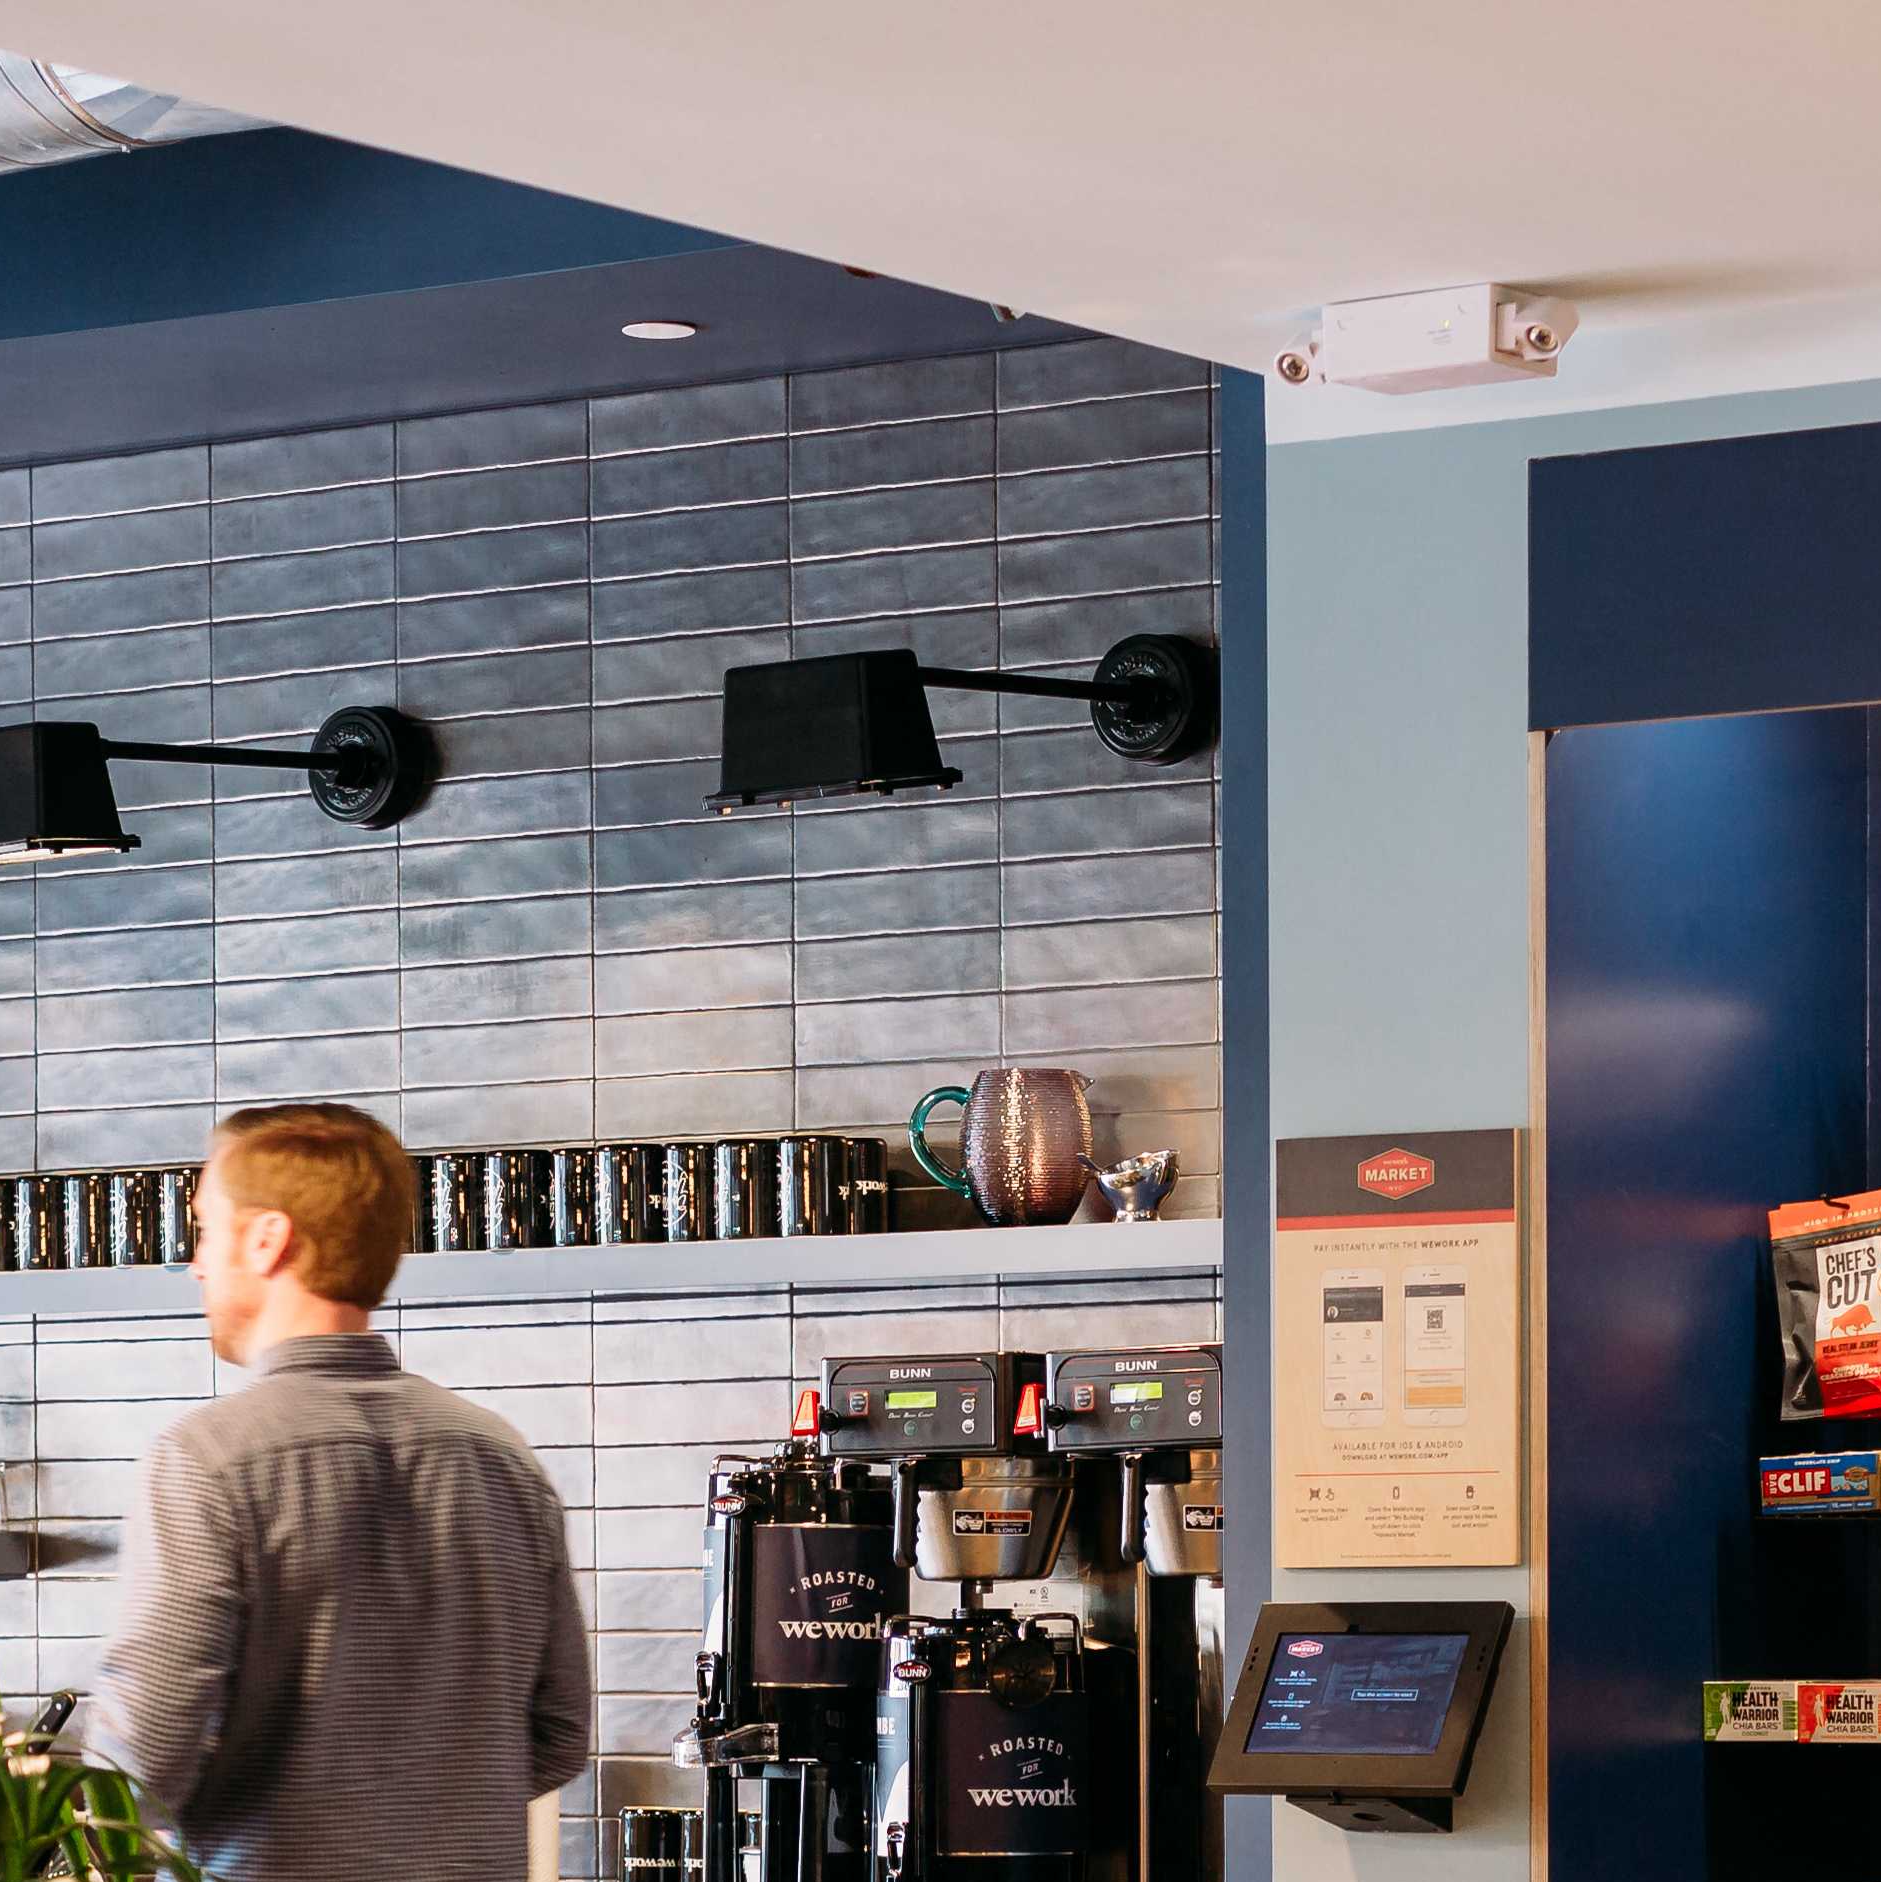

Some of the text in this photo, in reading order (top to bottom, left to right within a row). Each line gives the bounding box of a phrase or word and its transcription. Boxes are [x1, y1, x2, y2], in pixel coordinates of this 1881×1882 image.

[1365, 1167, 1428, 1182] MARKET
[1314, 1244, 1328, 1252] PAY
[1330, 1243, 1375, 1252] INSTANTLY
[1402, 1241, 1417, 1249] THE
[1421, 1240, 1460, 1248] WEWORK
[1462, 1238, 1479, 1247] APP
[1826, 1247, 1876, 1276] CHEF'S
[1827, 1269, 1877, 1309] CUT
[1115, 1360, 1158, 1372] BUNN
[889, 1368, 932, 1379] BUNN
[1333, 1442, 1375, 1450] AVAILABLE
[1379, 1442, 1396, 1450] FOR
[1425, 1440, 1463, 1449] ANDROID
[1777, 1470, 1827, 1493] CLIF
[712, 1501, 743, 1512] BUNN
[800, 1571, 876, 1591] ROASTED
[831, 1597, 848, 1608] FOR
[898, 1668, 928, 1677] BUNN
[1732, 1691, 1779, 1707] HEALTH
[1825, 1694, 1874, 1710] HEALTH
[1732, 1708, 1779, 1721] WARRIOR
[1826, 1711, 1874, 1725] WARRIOR
[1733, 1722, 1779, 1730] CHIA BARS
[1827, 1724, 1874, 1733] CHIA BARS
[989, 1737, 1063, 1757] ROASTED
[1022, 1763, 1039, 1774] FOR
[968, 1778, 1077, 1807] wework
[623, 1856, 676, 1872] wework
